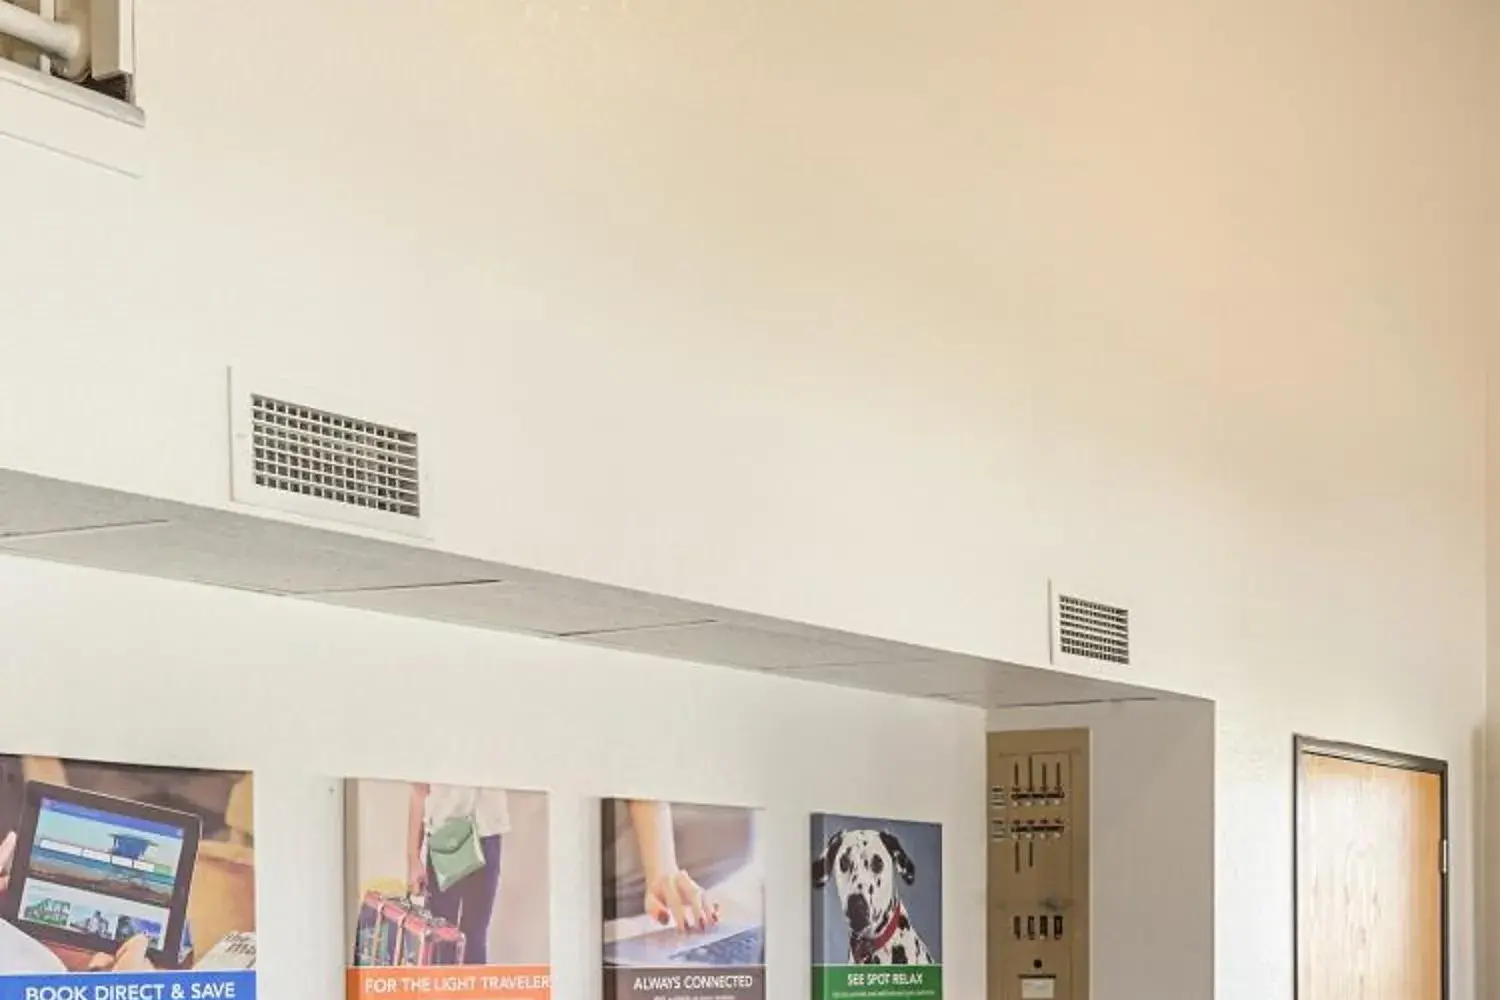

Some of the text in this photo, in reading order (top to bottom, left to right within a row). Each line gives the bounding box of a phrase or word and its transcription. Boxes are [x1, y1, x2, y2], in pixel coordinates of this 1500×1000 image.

[365, 978, 396, 993] FOR
[401, 976, 431, 992] THE
[434, 976, 476, 991] LIGHT
[634, 975, 753, 991] ALWAYS CONNECTED
[847, 972, 923, 986] SEE SPOT RELAX
[171, 984, 184, 1000] &
[191, 982, 236, 999] SAVE
